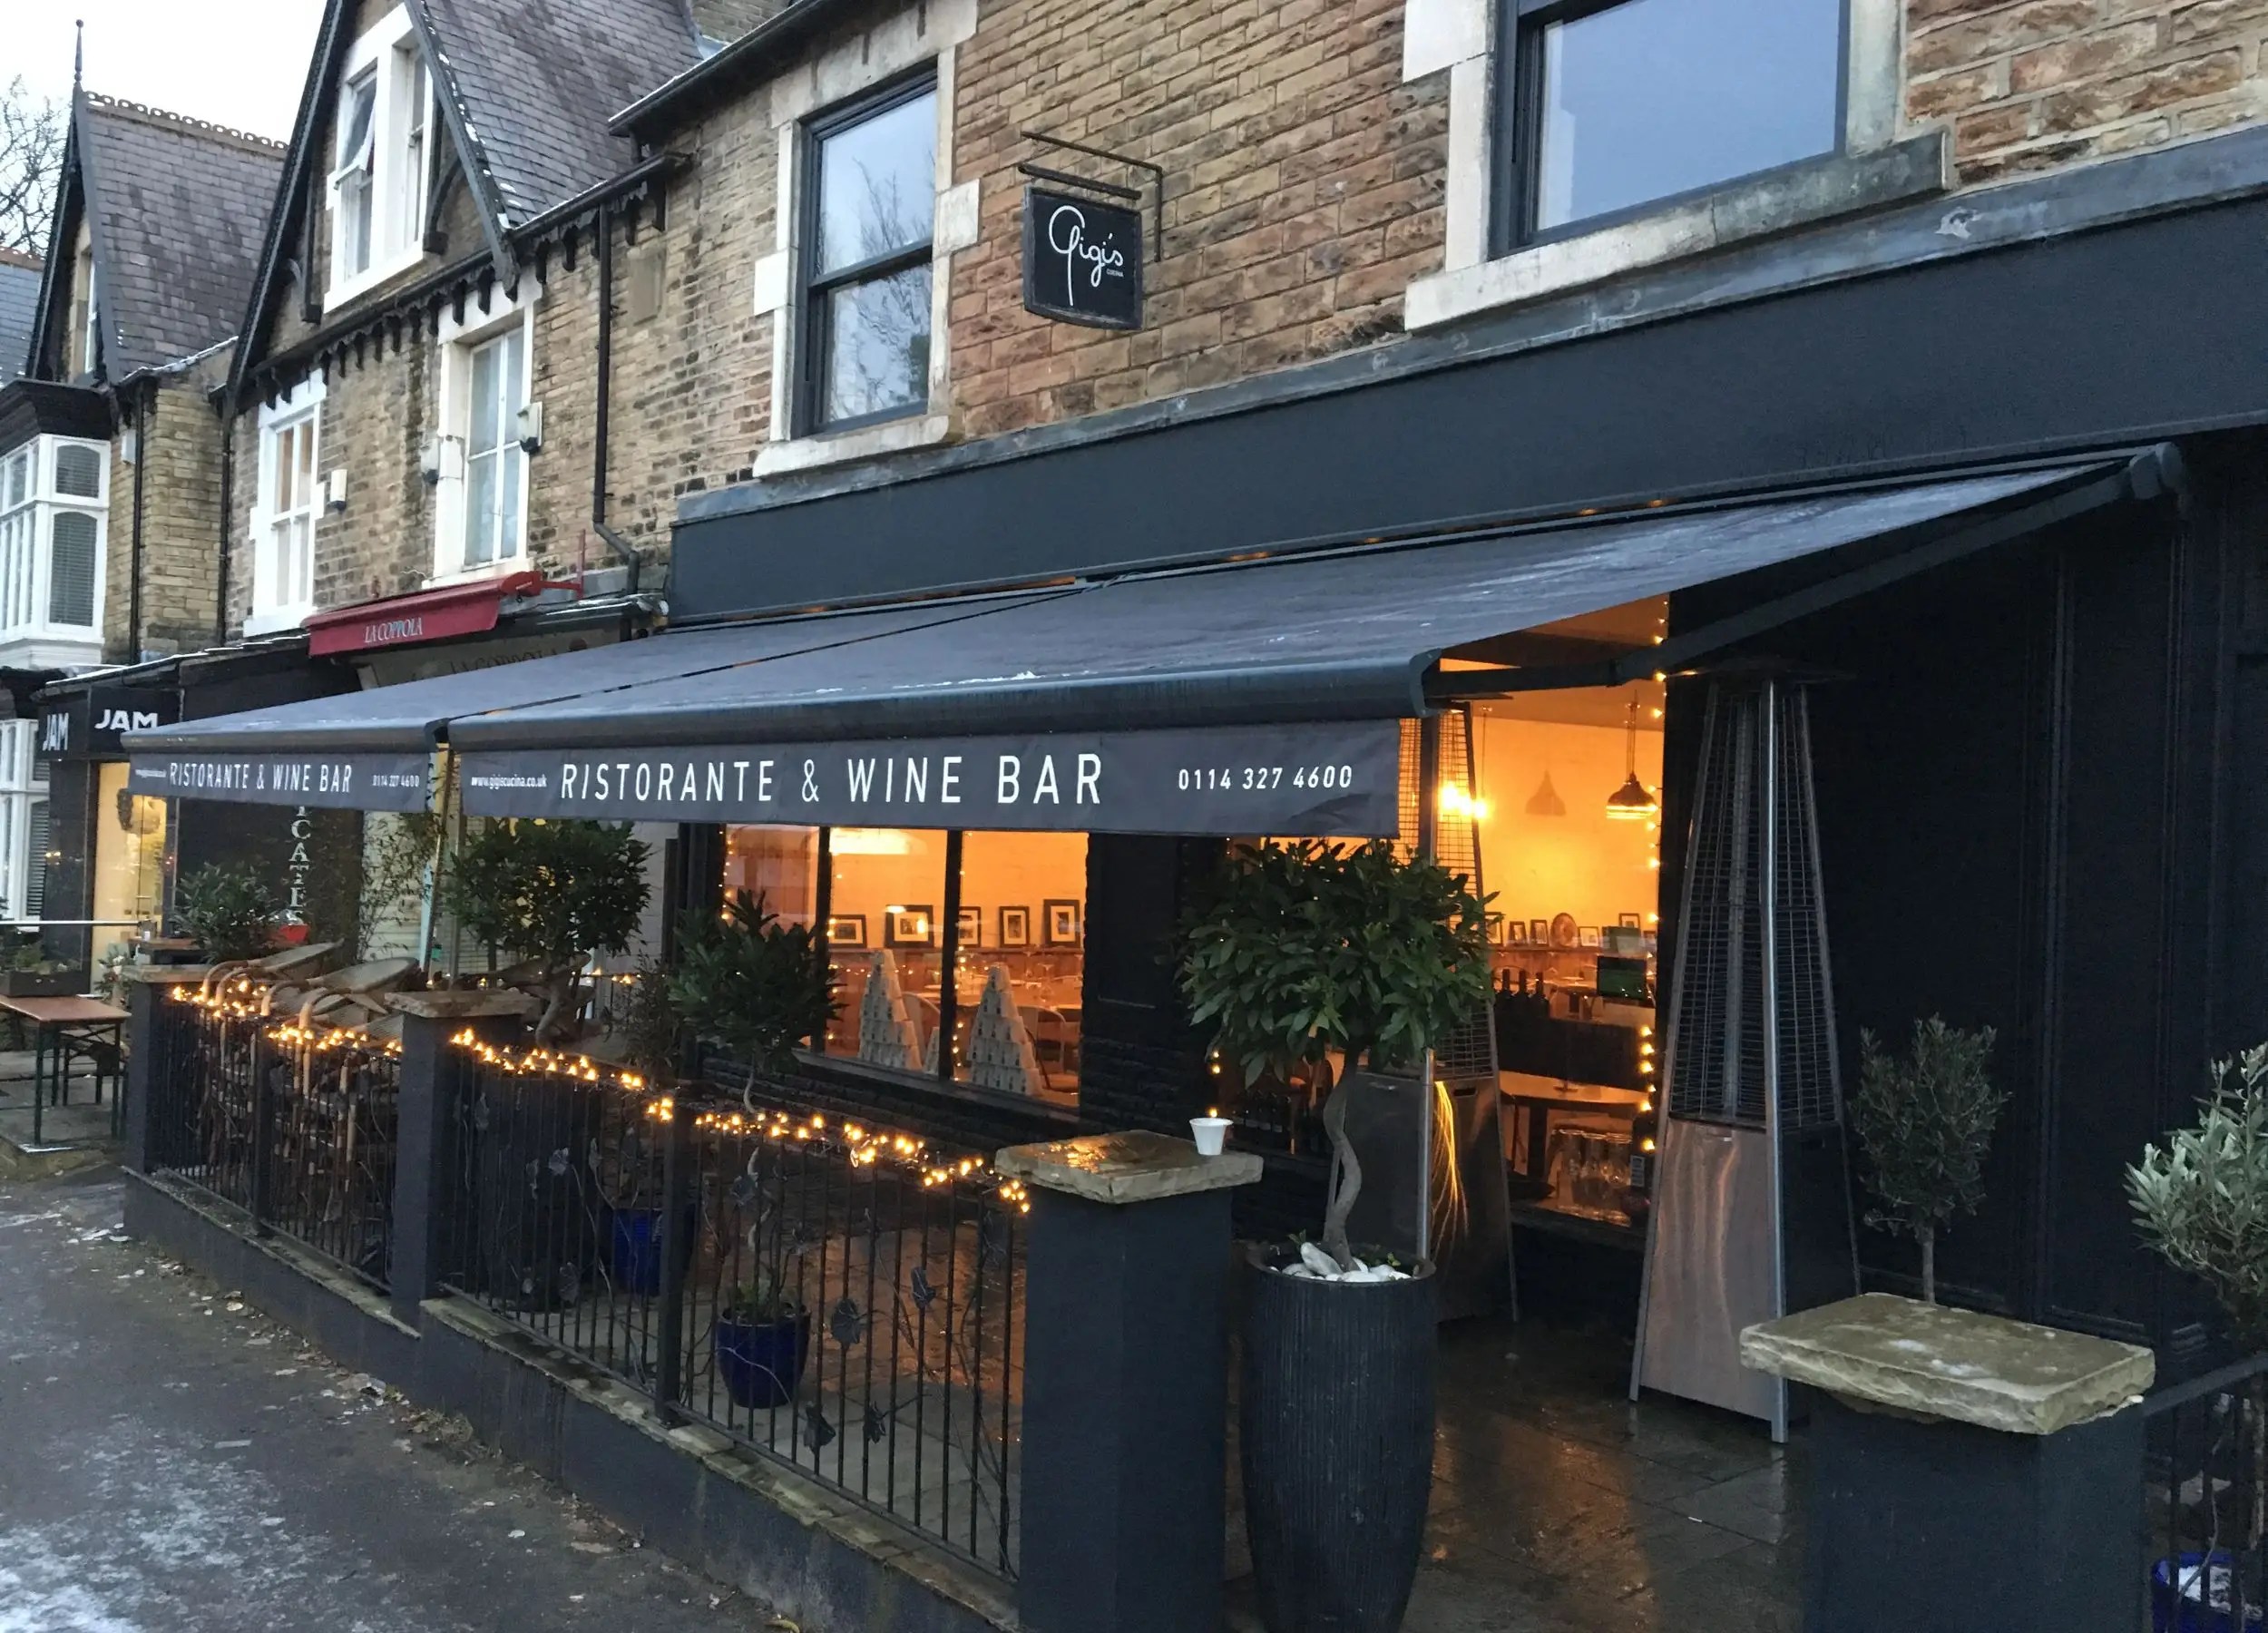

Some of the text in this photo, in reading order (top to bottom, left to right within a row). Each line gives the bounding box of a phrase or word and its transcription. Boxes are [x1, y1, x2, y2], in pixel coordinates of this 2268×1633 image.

[365, 617, 423, 643] LA COPPOLA
[42, 712, 70, 751] JAM
[94, 709, 159, 731] JAM
[170, 762, 249, 789] RISTORANTE
[256, 764, 265, 790] &
[273, 764, 311, 792] WINE
[319, 764, 352, 793] BAR
[471, 773, 547, 790] www.gigiscucina.co.uk
[561, 753, 1102, 805] RISTORANTE & WINE BAR
[1178, 765, 1353, 790] 0114 327 4600
